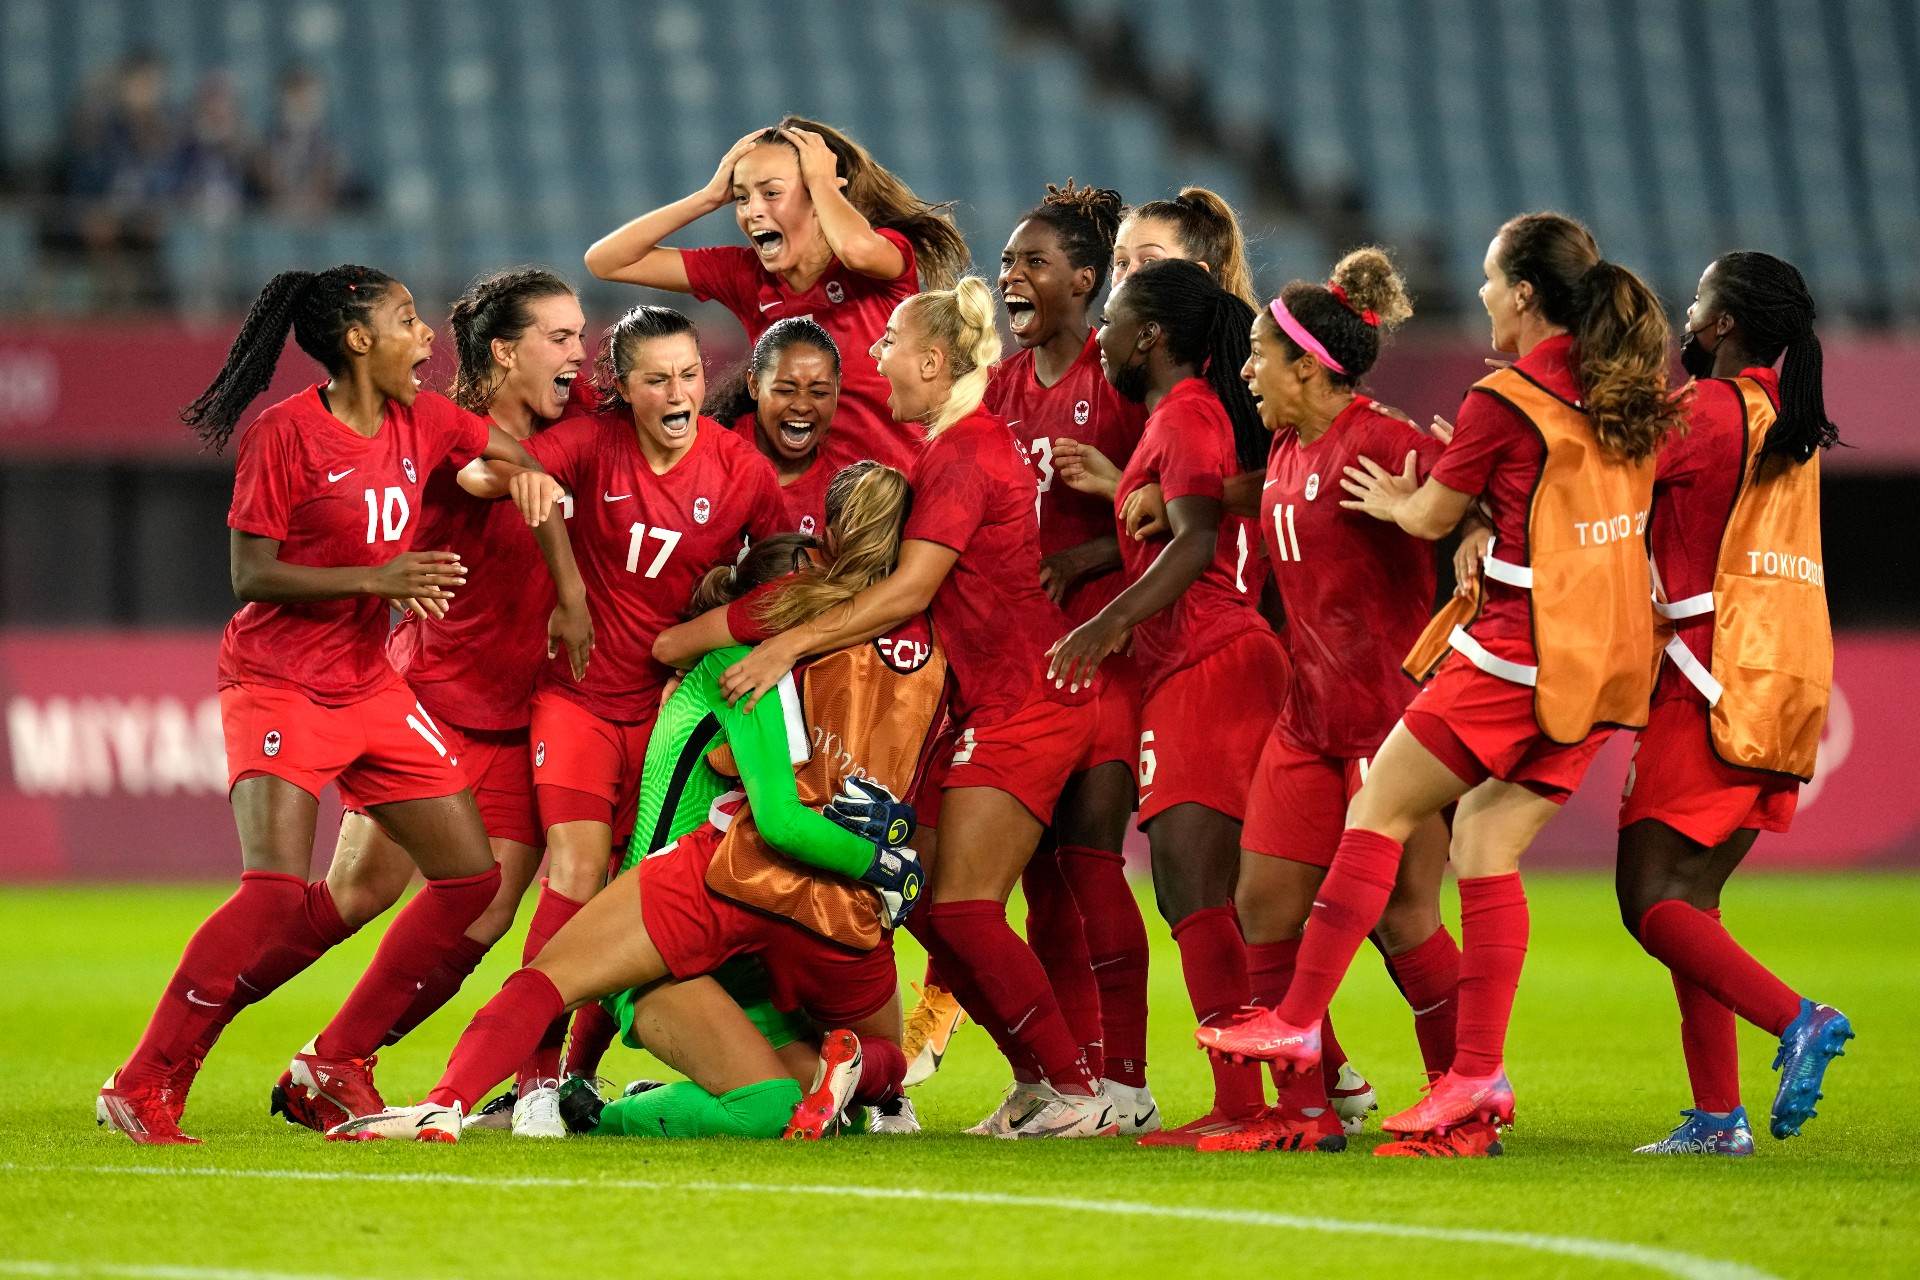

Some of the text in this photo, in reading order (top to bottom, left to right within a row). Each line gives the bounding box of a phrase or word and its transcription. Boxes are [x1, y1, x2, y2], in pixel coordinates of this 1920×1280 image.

[1031, 437, 1054, 492] 3
[364, 486, 410, 544] 10
[1272, 503, 1302, 562] 11
[625, 521, 682, 579] 17
[1746, 551, 1810, 580] TOKYO
[1139, 730, 1157, 788] 6
[1257, 1035, 1304, 1050] ULTRA
